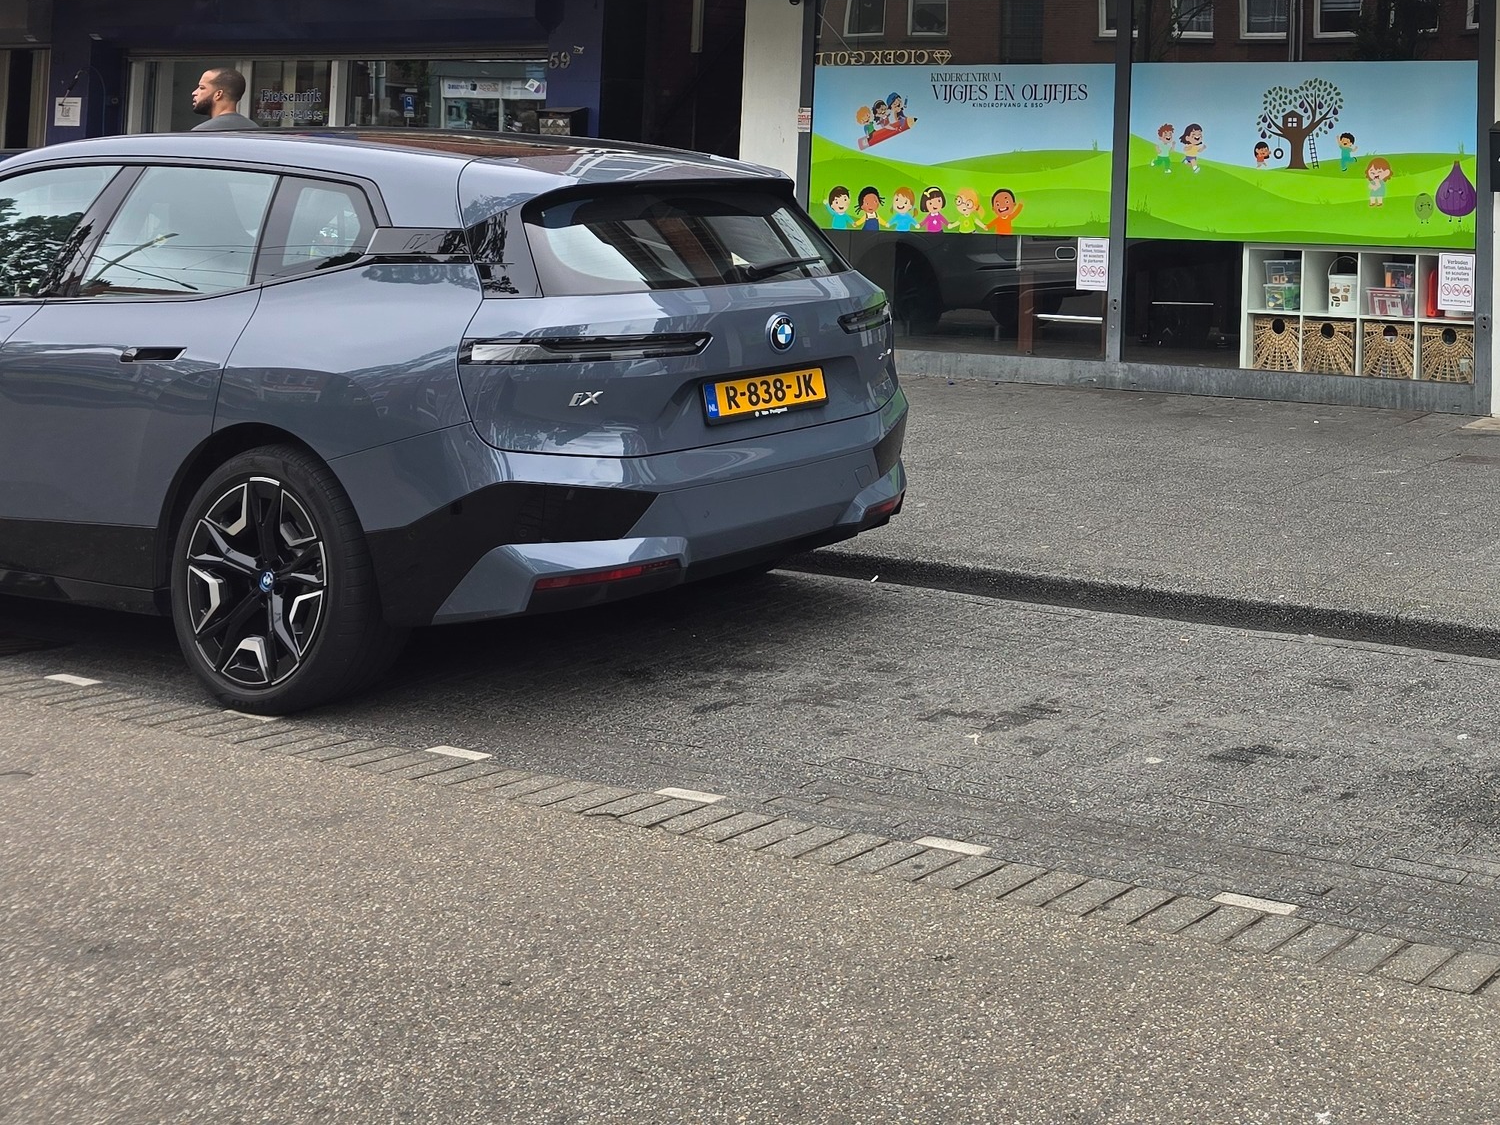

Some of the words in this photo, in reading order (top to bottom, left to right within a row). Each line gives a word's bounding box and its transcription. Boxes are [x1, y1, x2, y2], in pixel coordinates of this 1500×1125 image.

[549, 51, 570, 69] 59
[930, 73, 1002, 82] KINDERCENTRUM
[261, 88, 322, 106] Fietsenrijk
[932, 84, 988, 104] VIJGJES
[994, 84, 1015, 101] EN
[1021, 83, 1088, 104] OLIJFJES
[725, 374, 817, 410] R-838-JK
[709, 404, 717, 412] NL
